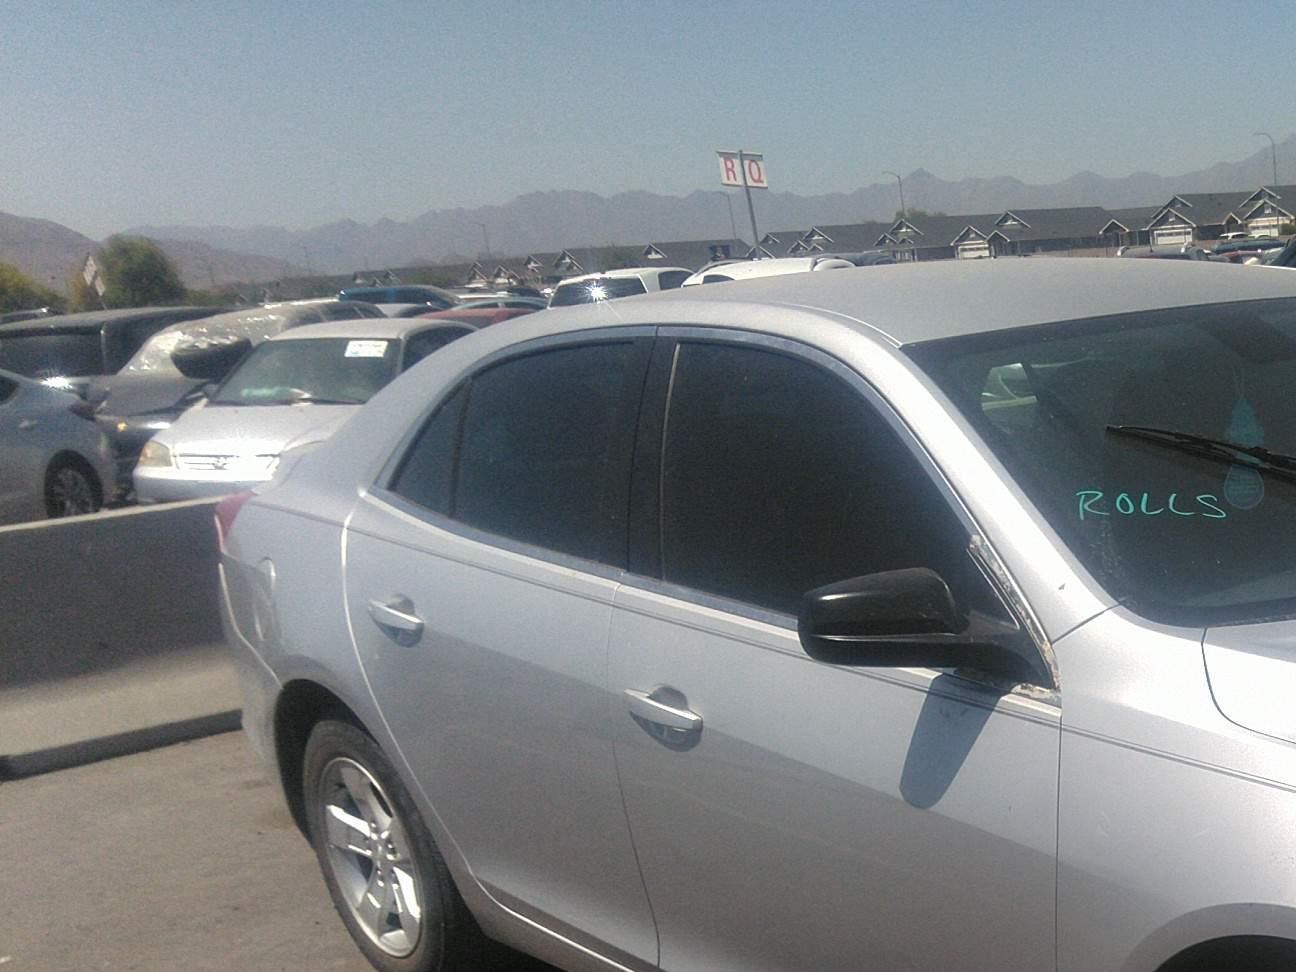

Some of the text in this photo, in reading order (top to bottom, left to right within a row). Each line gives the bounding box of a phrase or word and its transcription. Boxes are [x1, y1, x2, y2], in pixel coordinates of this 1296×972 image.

[723, 157, 765, 184] R Q
[1075, 490, 1227, 520] ROLLS
